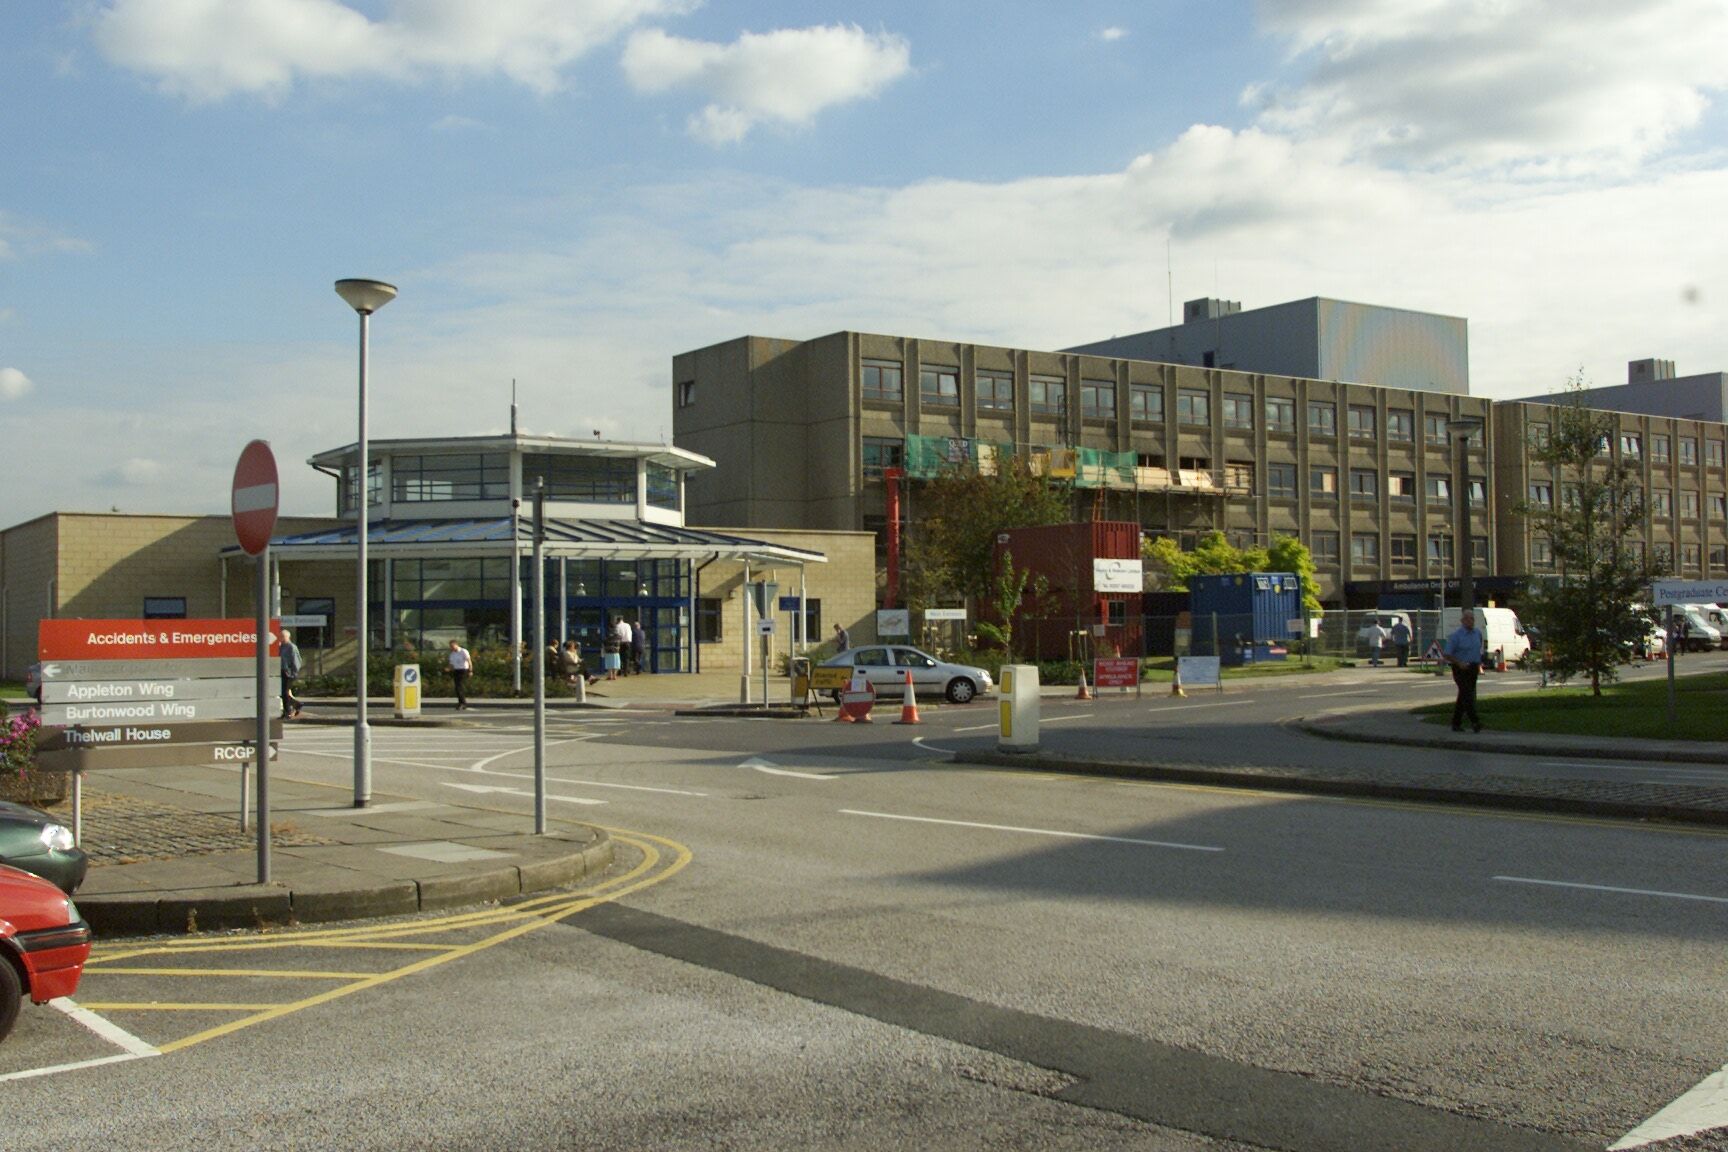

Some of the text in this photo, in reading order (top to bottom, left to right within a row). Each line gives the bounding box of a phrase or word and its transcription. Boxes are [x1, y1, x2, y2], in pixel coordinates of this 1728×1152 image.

[87, 632, 258, 646] Accidents & Emergencies
[67, 682, 174, 699] Appleton Wing
[66, 703, 196, 719] Burtonwood Wing
[63, 727, 171, 743] Thelwall House
[214, 746, 256, 760] RCGP
